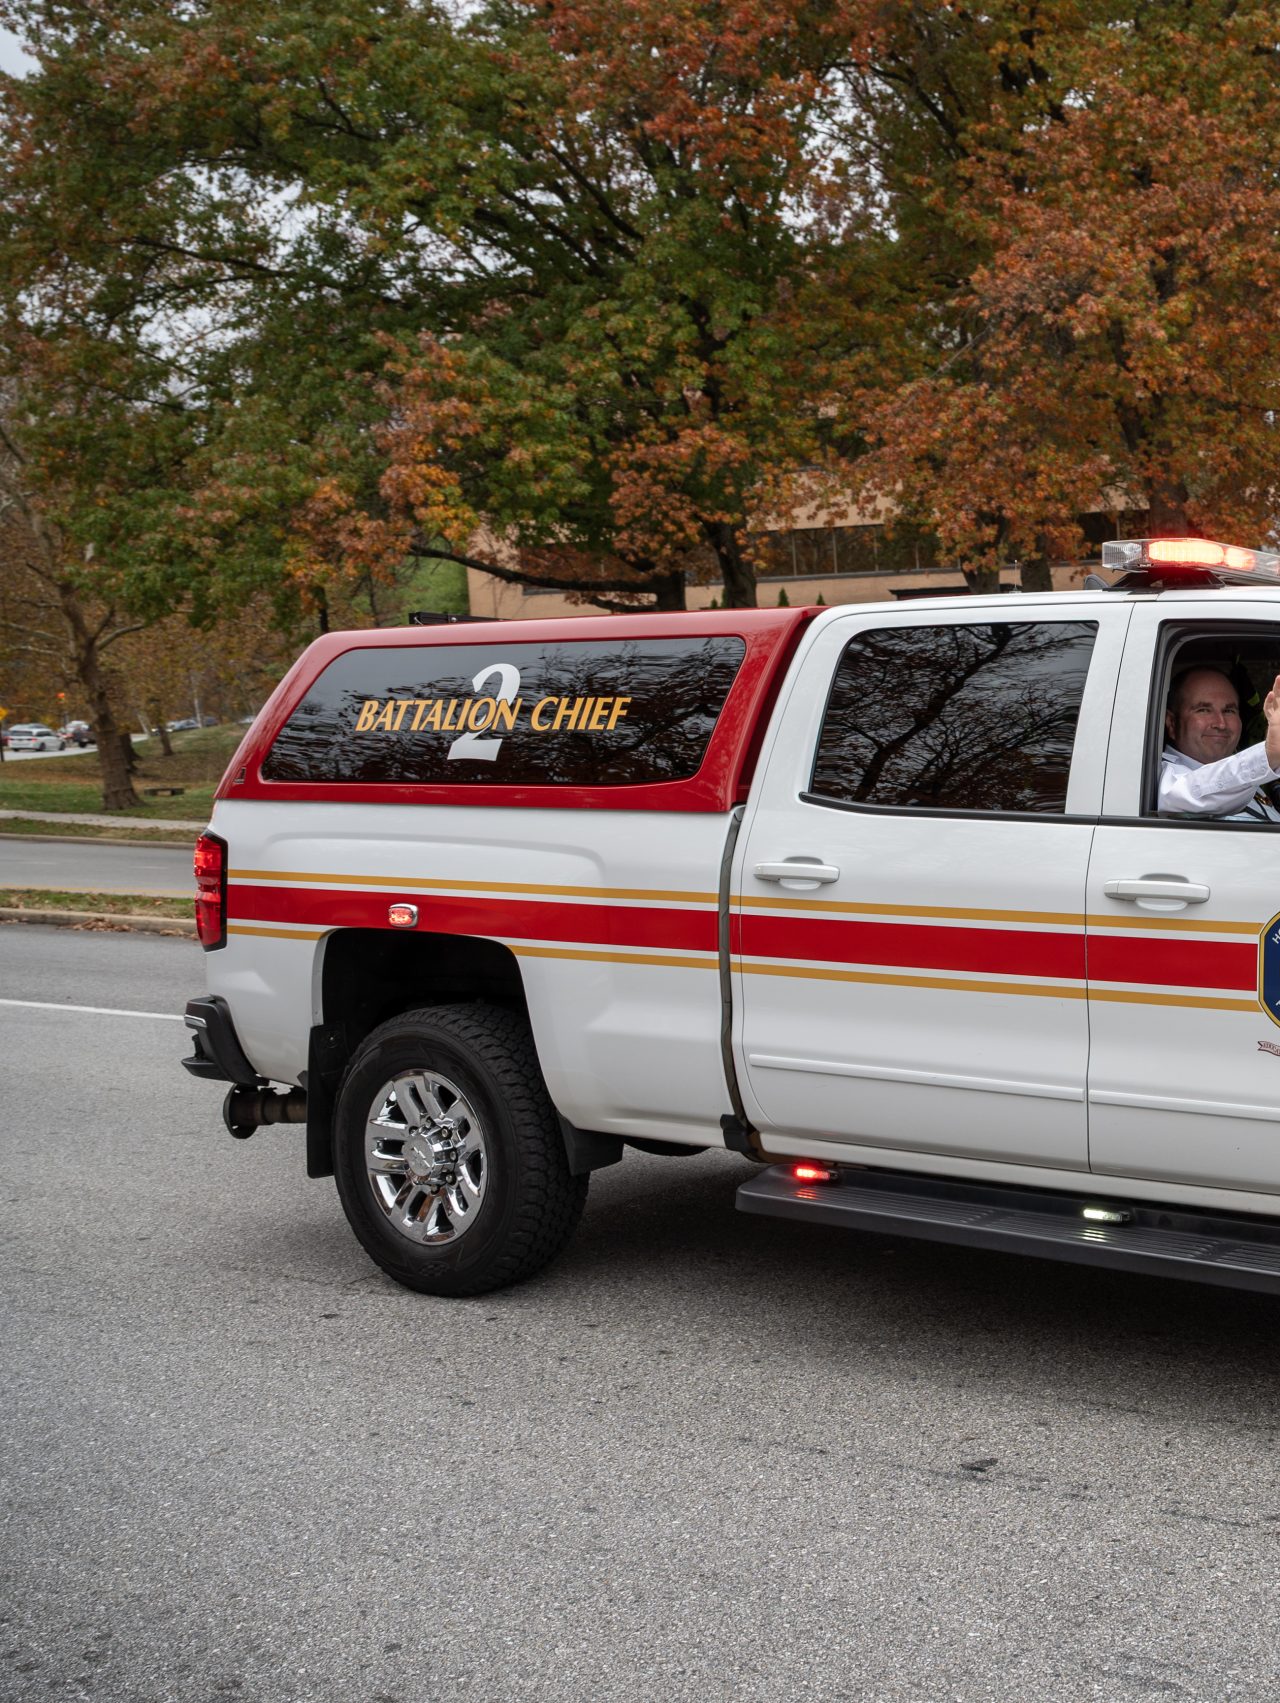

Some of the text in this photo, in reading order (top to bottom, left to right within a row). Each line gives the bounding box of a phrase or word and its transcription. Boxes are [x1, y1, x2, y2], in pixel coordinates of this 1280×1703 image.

[354, 696, 632, 732] BATTALION CHIEF
[447, 663, 521, 762] 2
